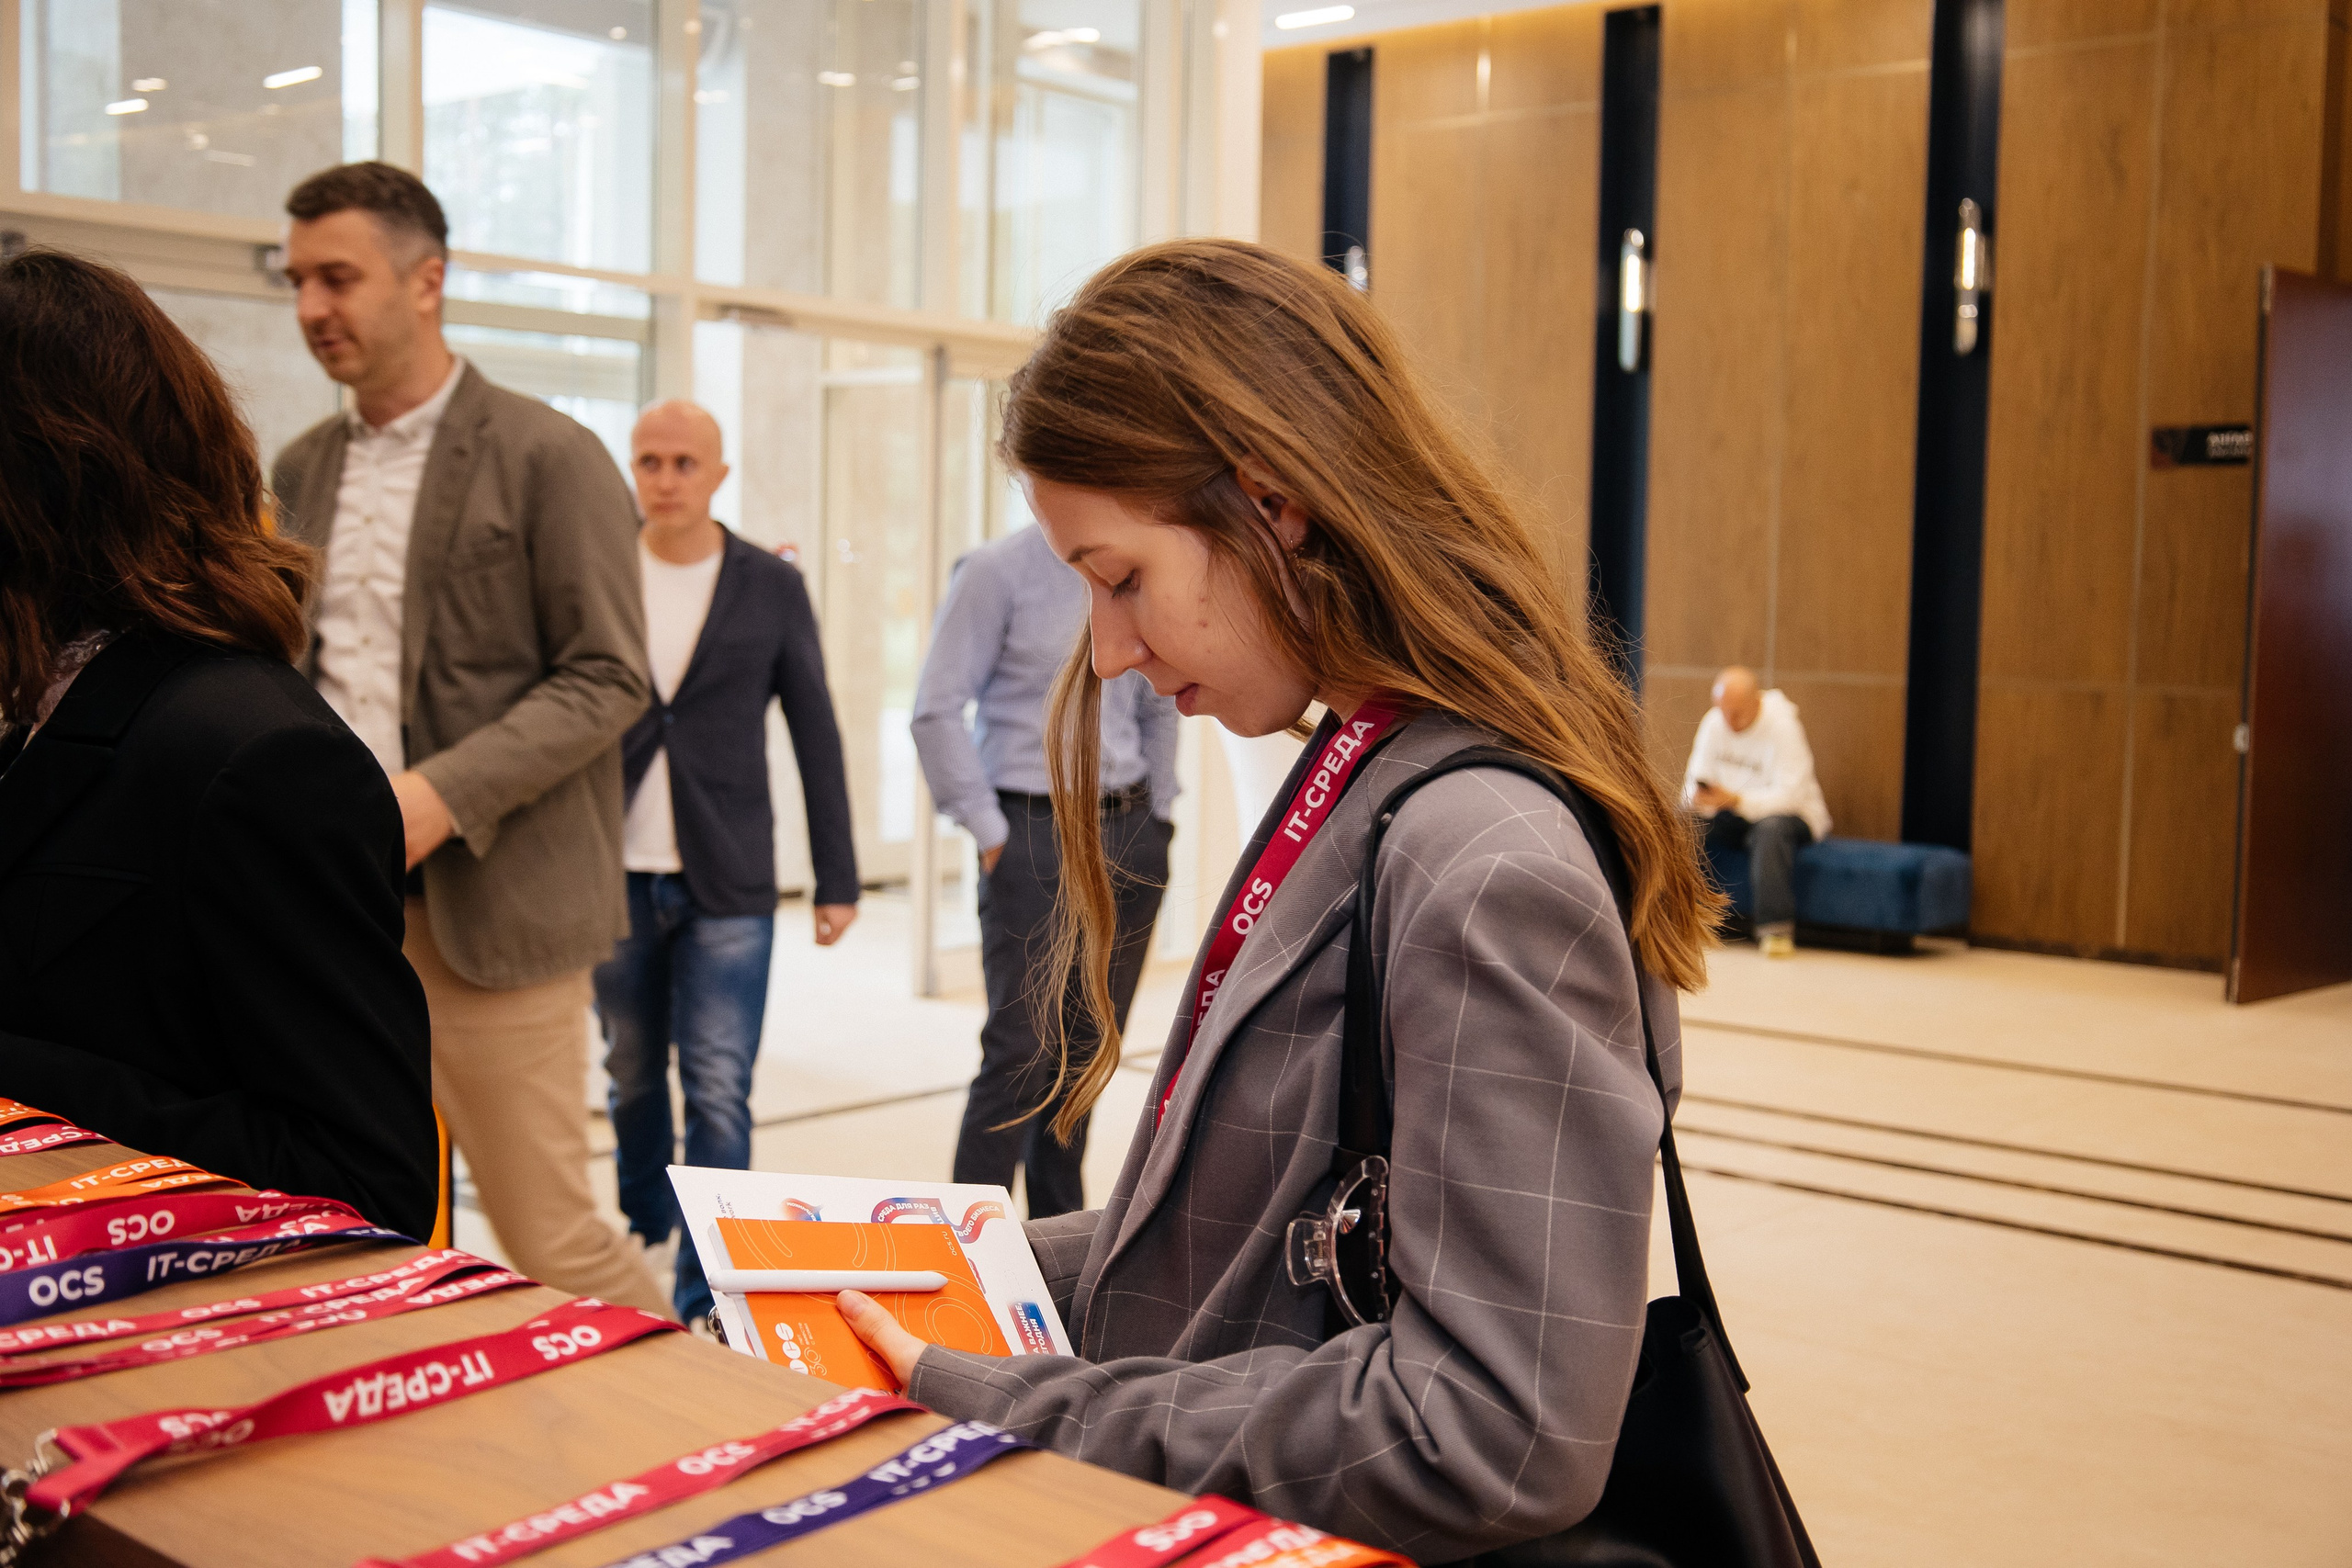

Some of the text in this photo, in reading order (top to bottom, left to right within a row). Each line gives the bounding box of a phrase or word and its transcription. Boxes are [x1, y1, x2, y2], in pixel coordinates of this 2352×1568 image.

[1232, 877, 1273, 937] OCS
[107, 1210, 175, 1246] OCS
[877, 1204, 897, 1223] СРЕДА
[895, 1202, 913, 1211] ДЛЯ
[956, 1218, 976, 1237] ВОЕГО
[970, 1204, 1001, 1220] БИЗНЕСА
[28, 1266, 105, 1306] OCS
[323, 1325, 602, 1422] OCS IT-СРЕДА
[676, 1442, 756, 1475] OCS
